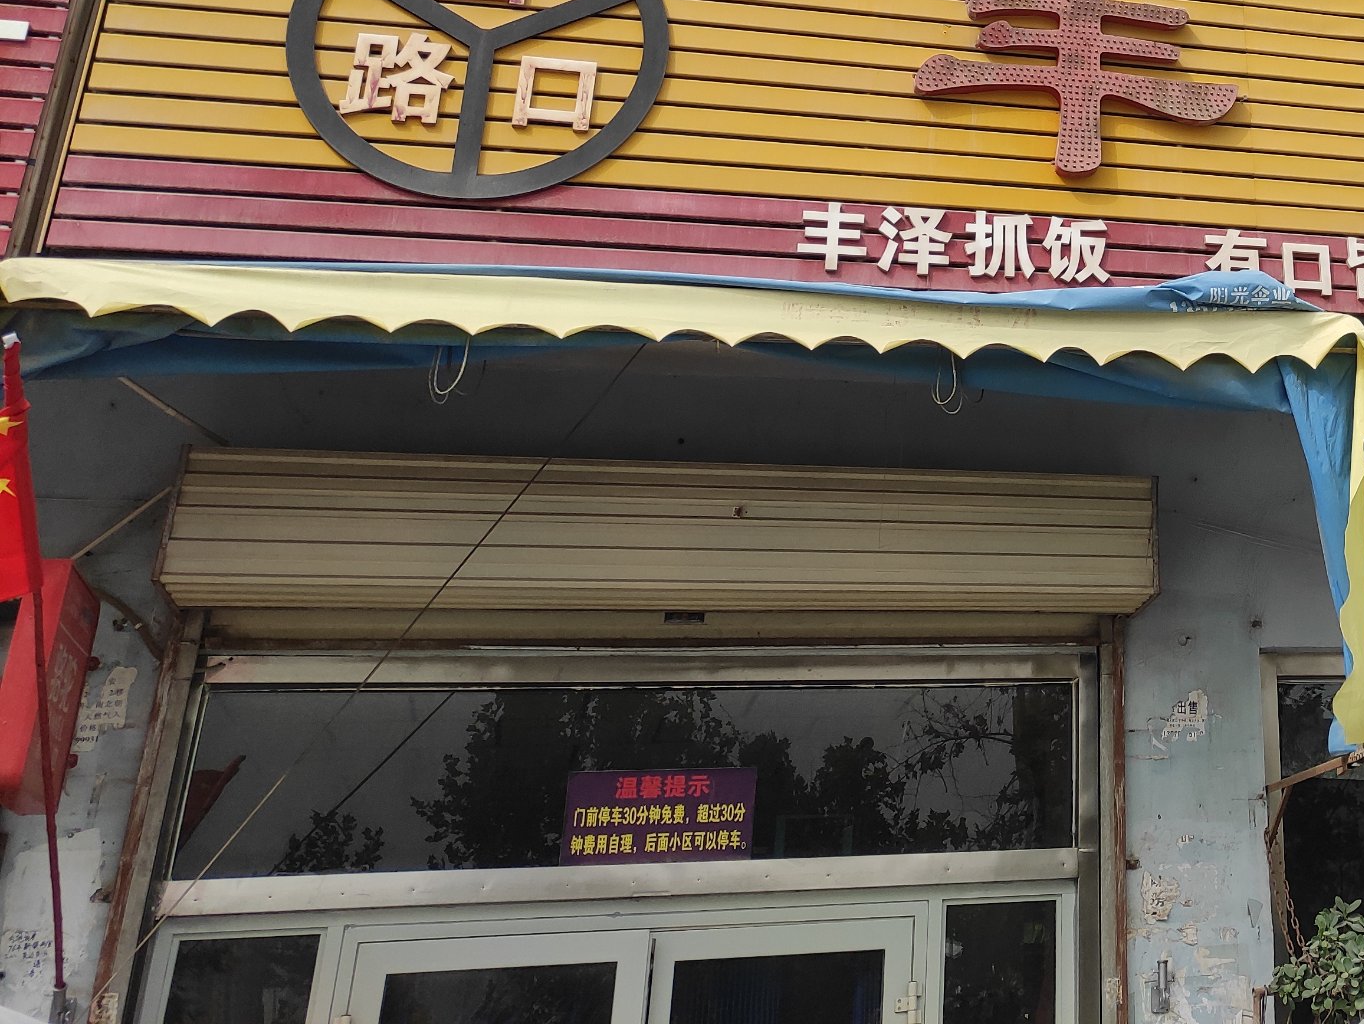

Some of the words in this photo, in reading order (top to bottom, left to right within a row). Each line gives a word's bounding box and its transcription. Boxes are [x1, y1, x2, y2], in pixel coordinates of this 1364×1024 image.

[797, 202, 1111, 284] 丰泽抓饭
[1209, 284, 1292, 306] 阳光伞业
[615, 775, 712, 799] 温馨提示
